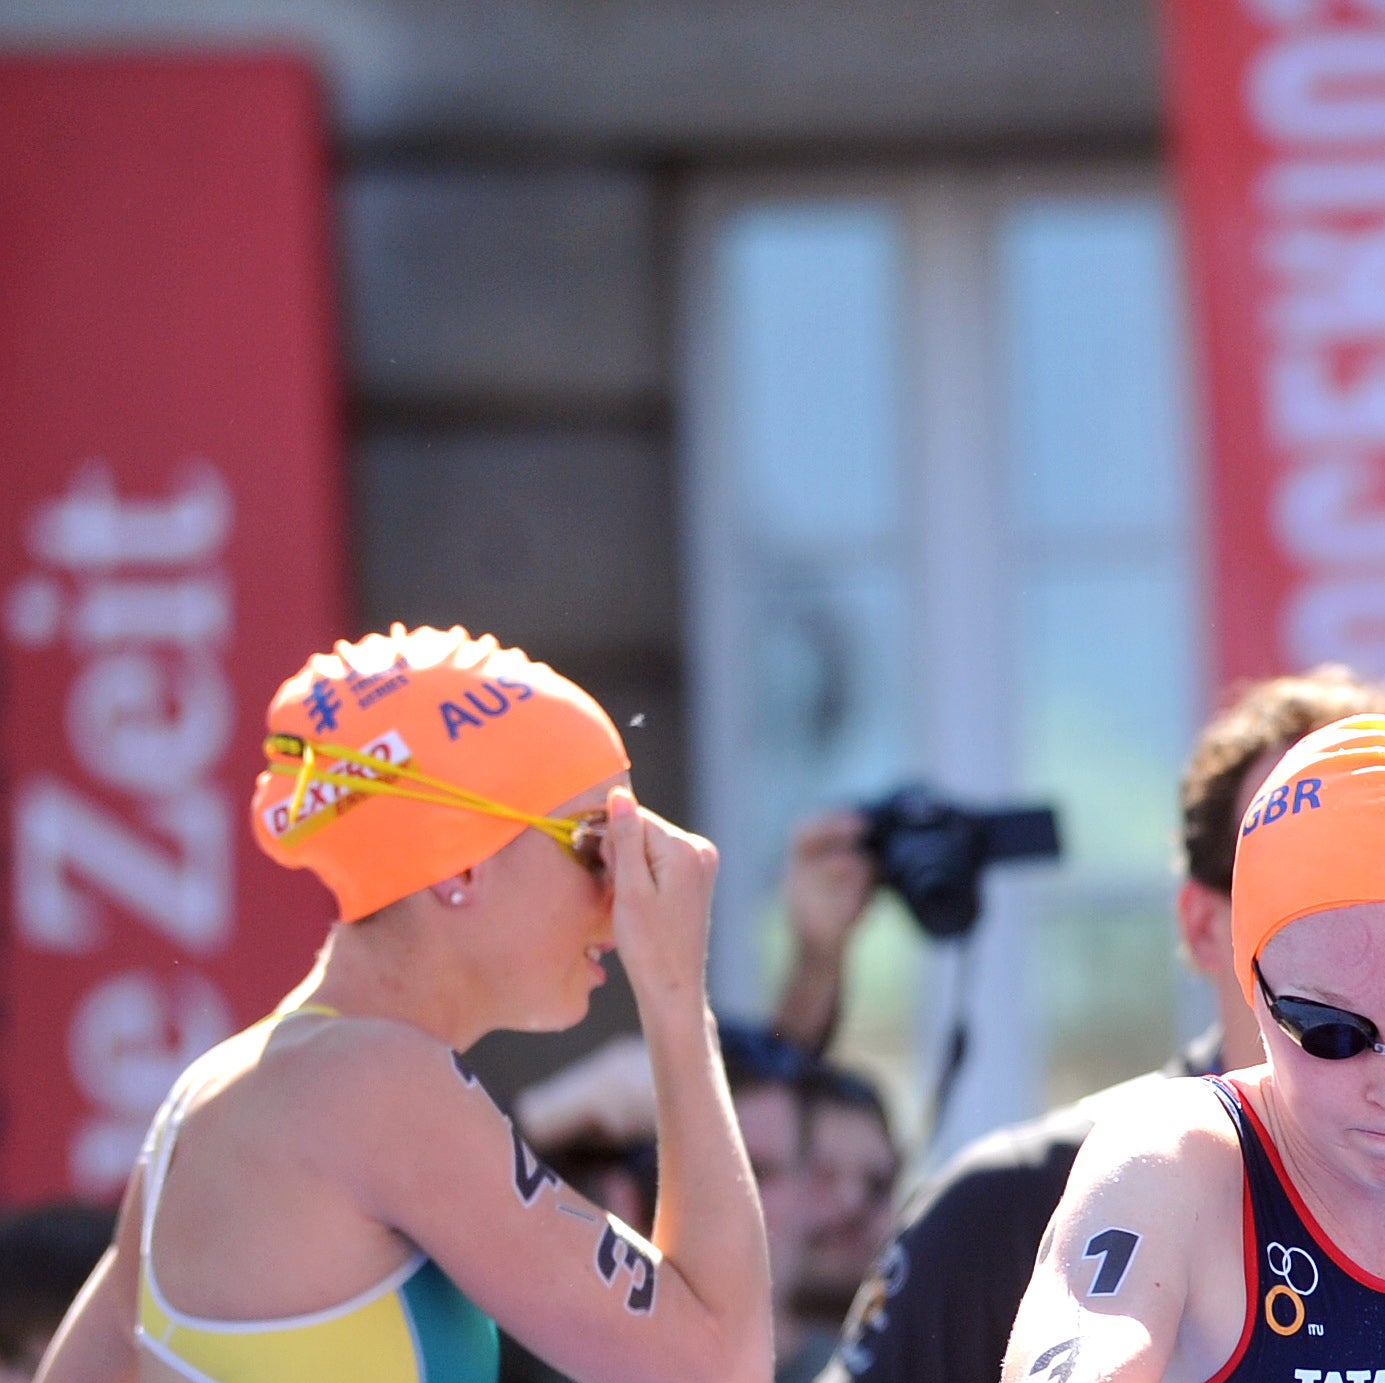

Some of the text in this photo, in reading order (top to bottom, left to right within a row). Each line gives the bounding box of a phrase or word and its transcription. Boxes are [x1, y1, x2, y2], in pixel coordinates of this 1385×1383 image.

[5, 458, 236, 952] Zeit
[437, 677, 534, 742] AUS
[1081, 1226, 1145, 1298] 1
[1307, 1323, 1325, 1337] ITU
